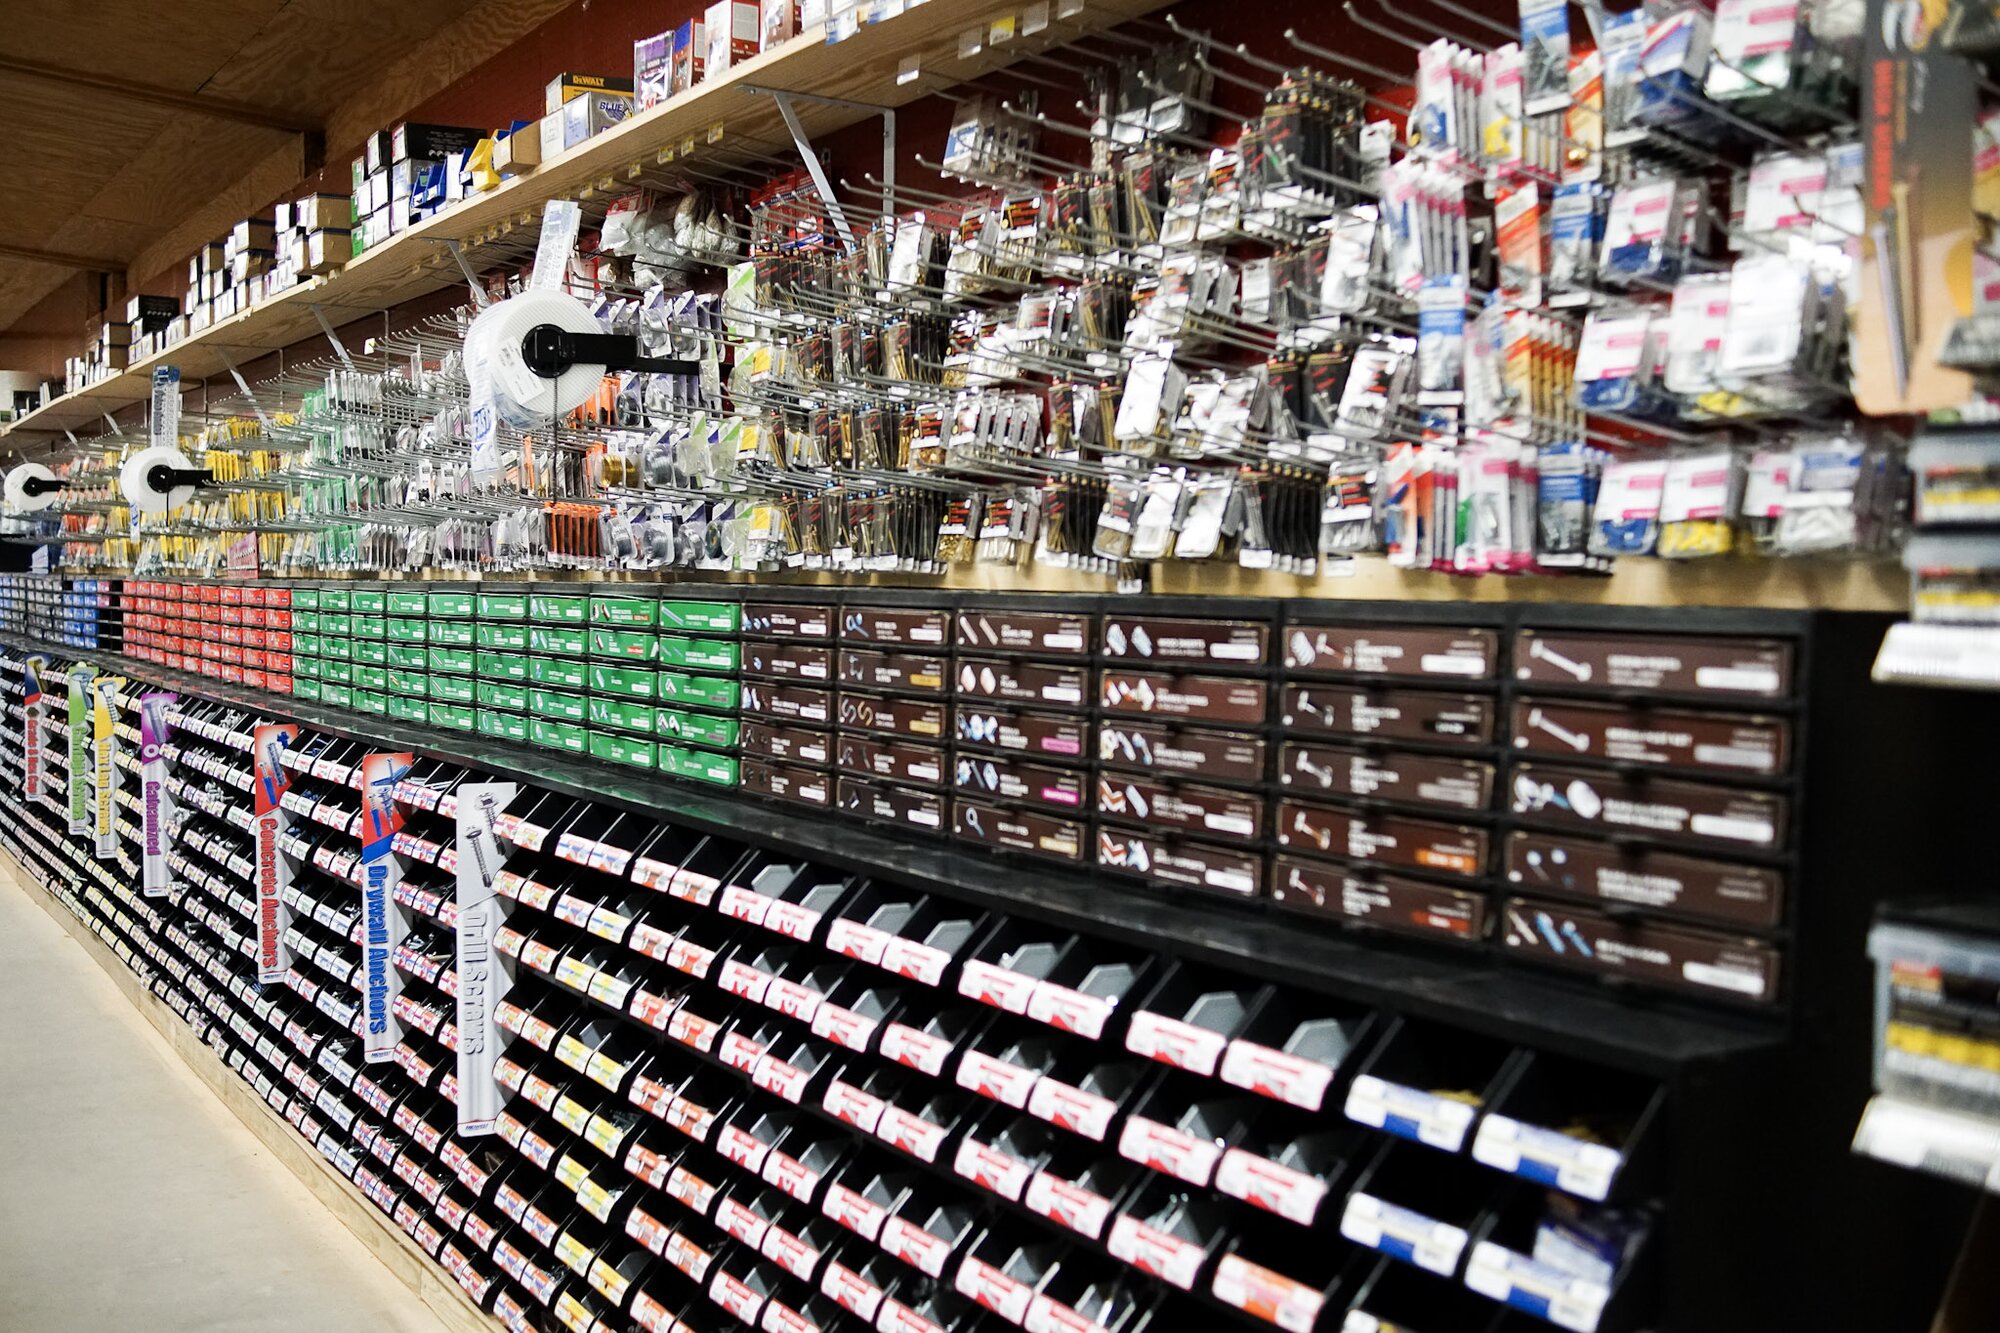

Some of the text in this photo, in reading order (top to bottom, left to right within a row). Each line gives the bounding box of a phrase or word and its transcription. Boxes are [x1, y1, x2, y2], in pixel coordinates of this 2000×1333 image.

[599, 101, 624, 113] BLUE
[97, 743, 112, 836] Hex Lag Screws
[145, 781, 162, 856] Galvanized
[259, 818, 279, 968] Concrete Anchors
[368, 865, 389, 1034] Drywall Anchors
[463, 911, 489, 1055] Drill Screws
